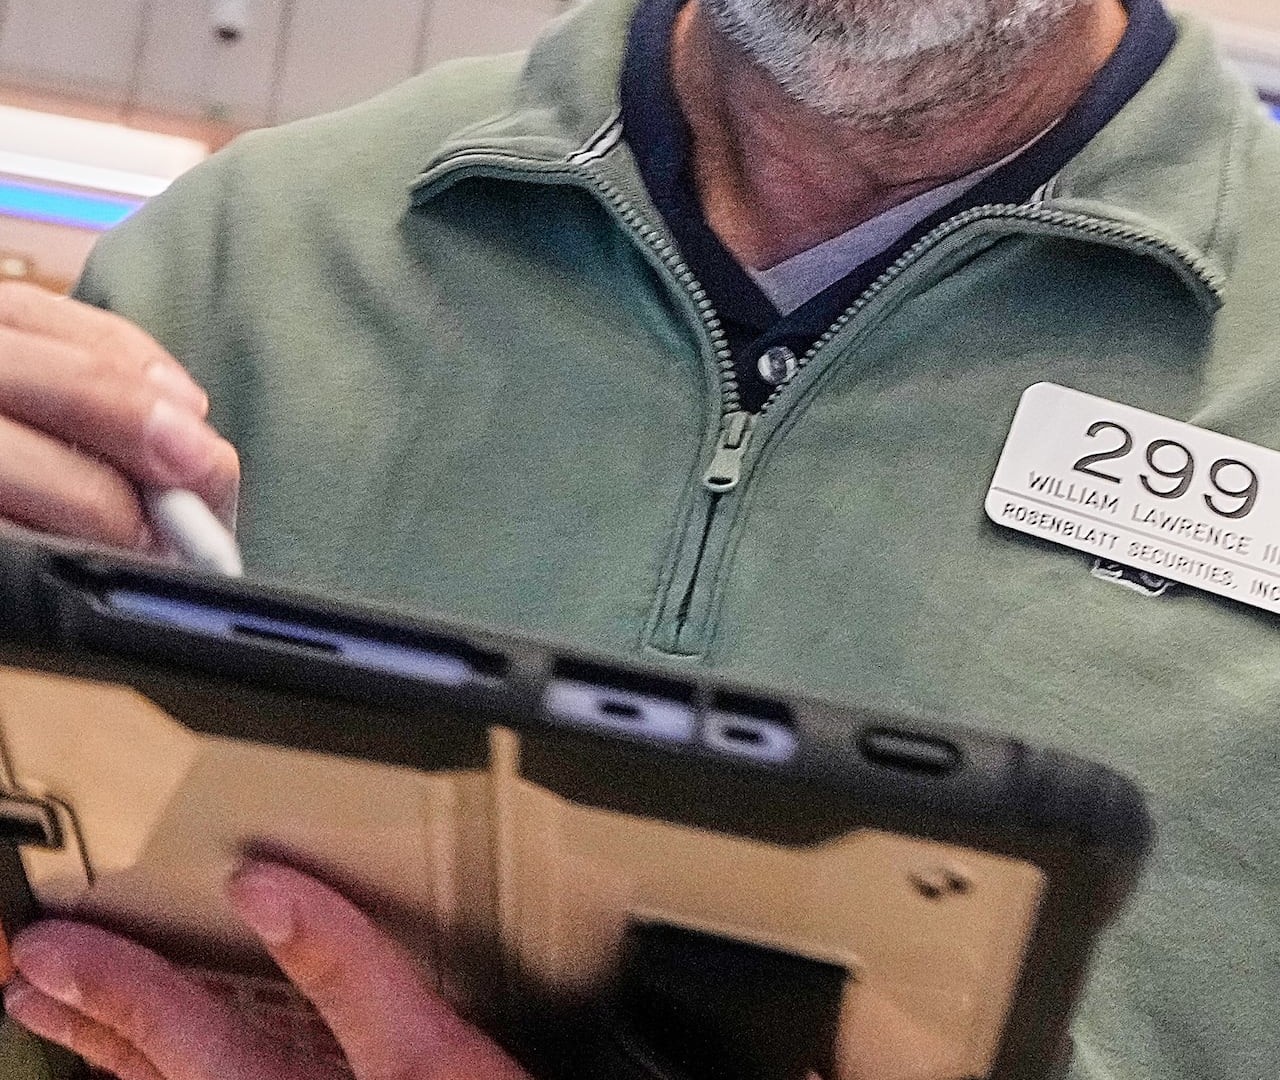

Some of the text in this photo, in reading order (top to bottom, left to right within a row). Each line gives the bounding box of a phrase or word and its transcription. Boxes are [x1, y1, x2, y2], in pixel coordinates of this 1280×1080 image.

[1028, 470, 1120, 514] WILLIAM
[1131, 503, 1253, 555] LAWRENCE
[1072, 421, 1259, 519] 299
[1001, 502, 1119, 551] ROSENBLATT
